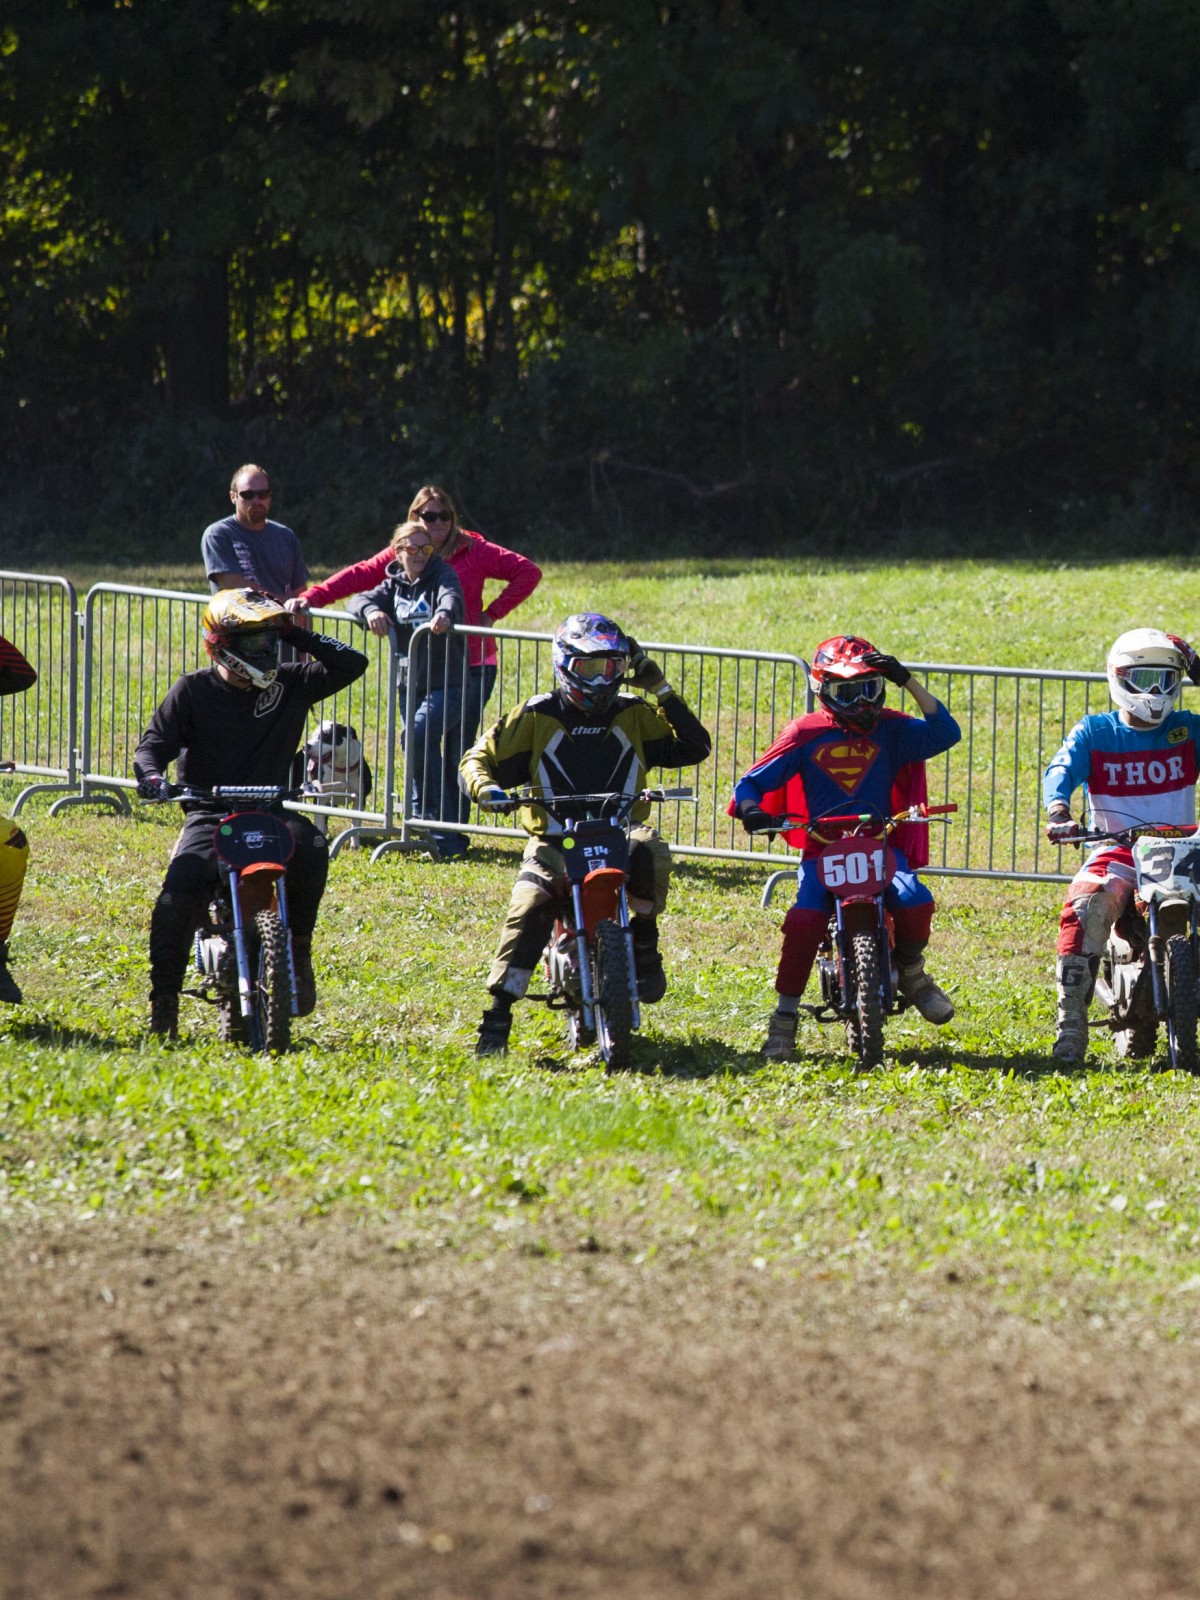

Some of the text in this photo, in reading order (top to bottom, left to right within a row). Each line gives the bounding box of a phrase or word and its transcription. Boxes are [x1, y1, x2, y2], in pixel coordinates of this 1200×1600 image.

[571, 725, 606, 736] thor
[1103, 756, 1184, 786] THOR
[1135, 830, 1183, 838] HONDA
[583, 845, 608, 857] 214
[822, 849, 886, 887] 501
